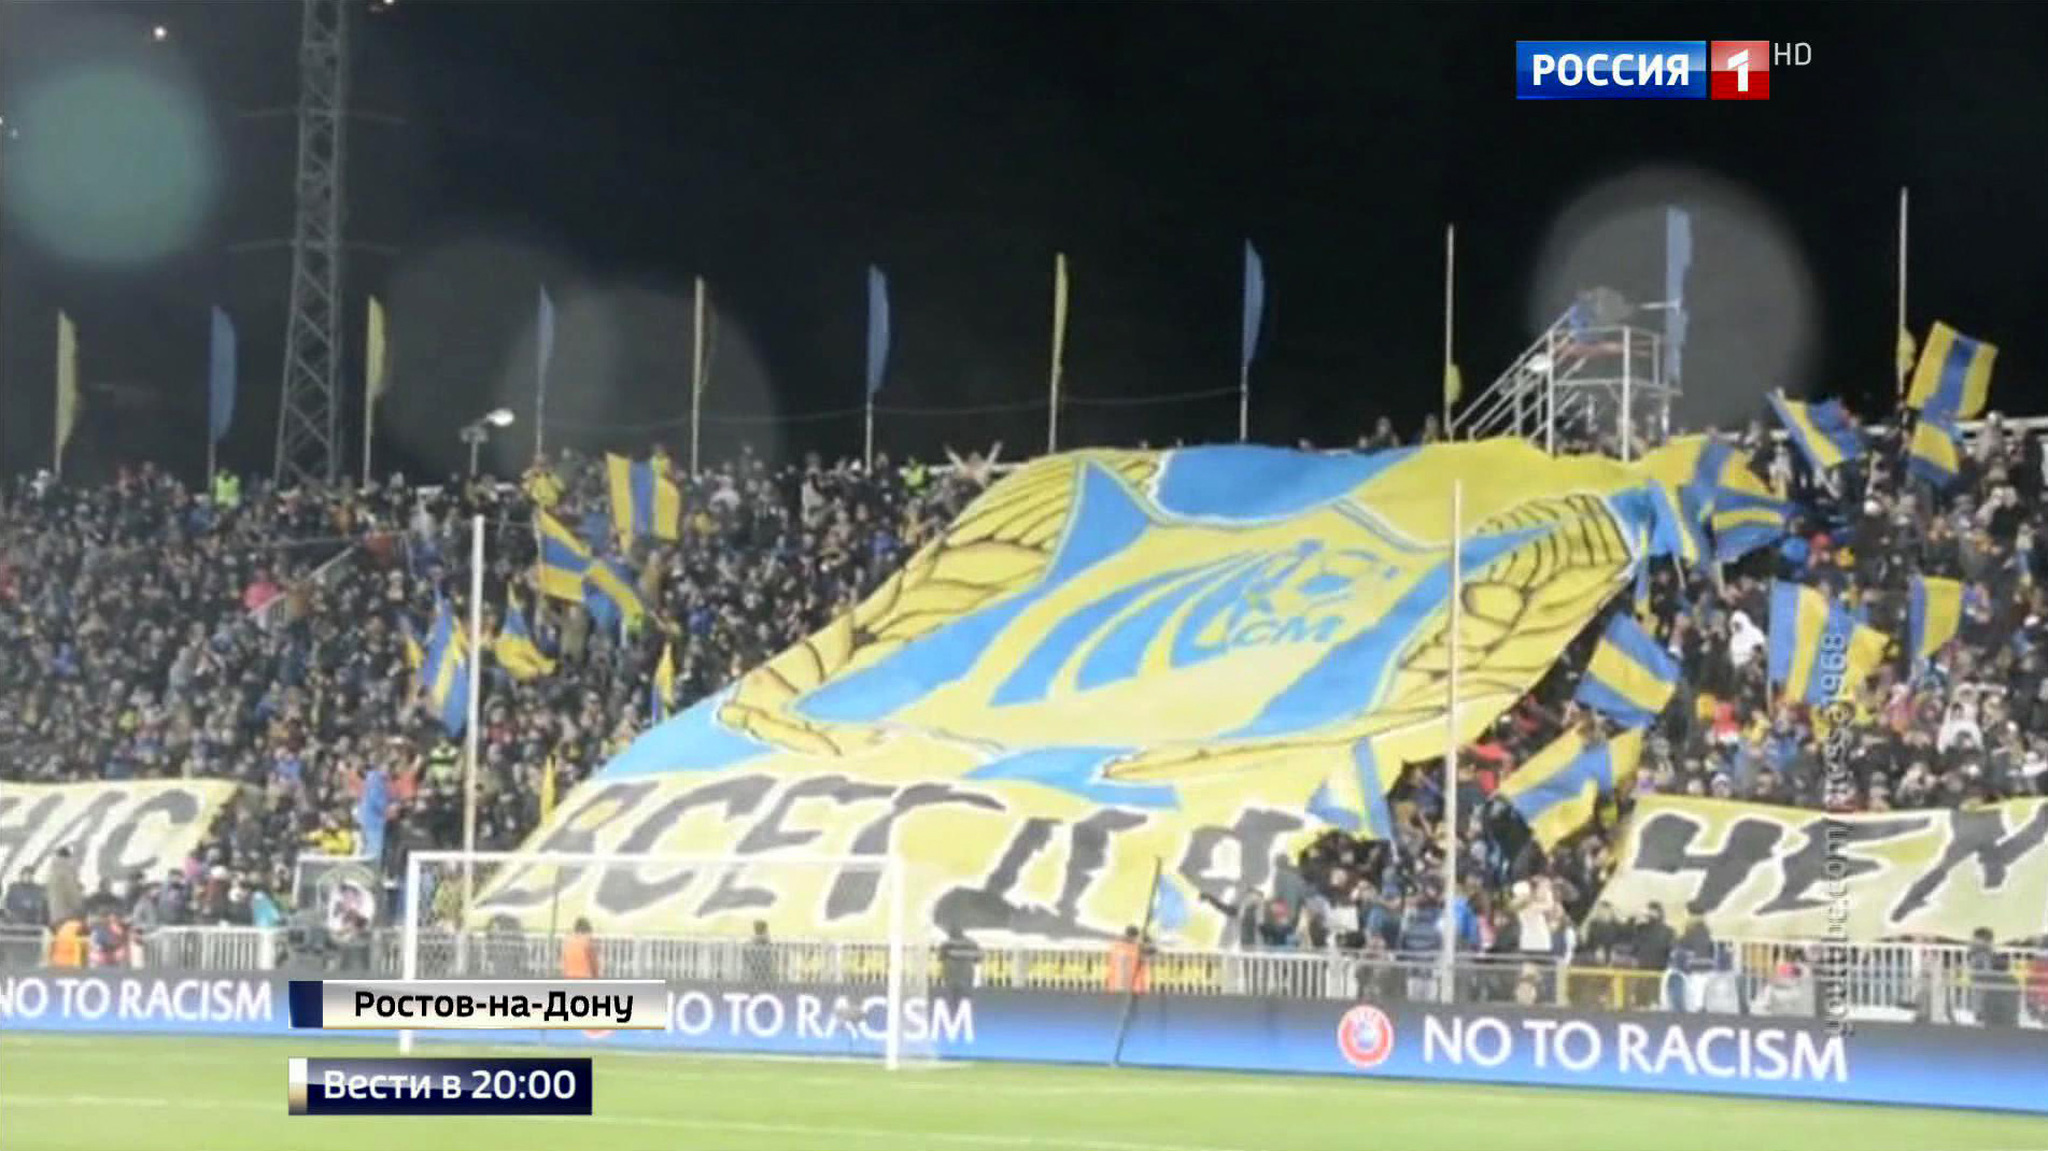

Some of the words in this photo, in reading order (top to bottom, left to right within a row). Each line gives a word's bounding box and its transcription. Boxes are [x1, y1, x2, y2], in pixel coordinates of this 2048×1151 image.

[55, 978, 111, 1020] TO
[117, 978, 274, 1023] RACISM
[722, 992, 785, 1038] TO
[796, 993, 974, 1044] RACSM
[1422, 1014, 1512, 1067] NO
[1522, 1018, 1602, 1072] TO
[1617, 1023, 1849, 1083] RACISM
